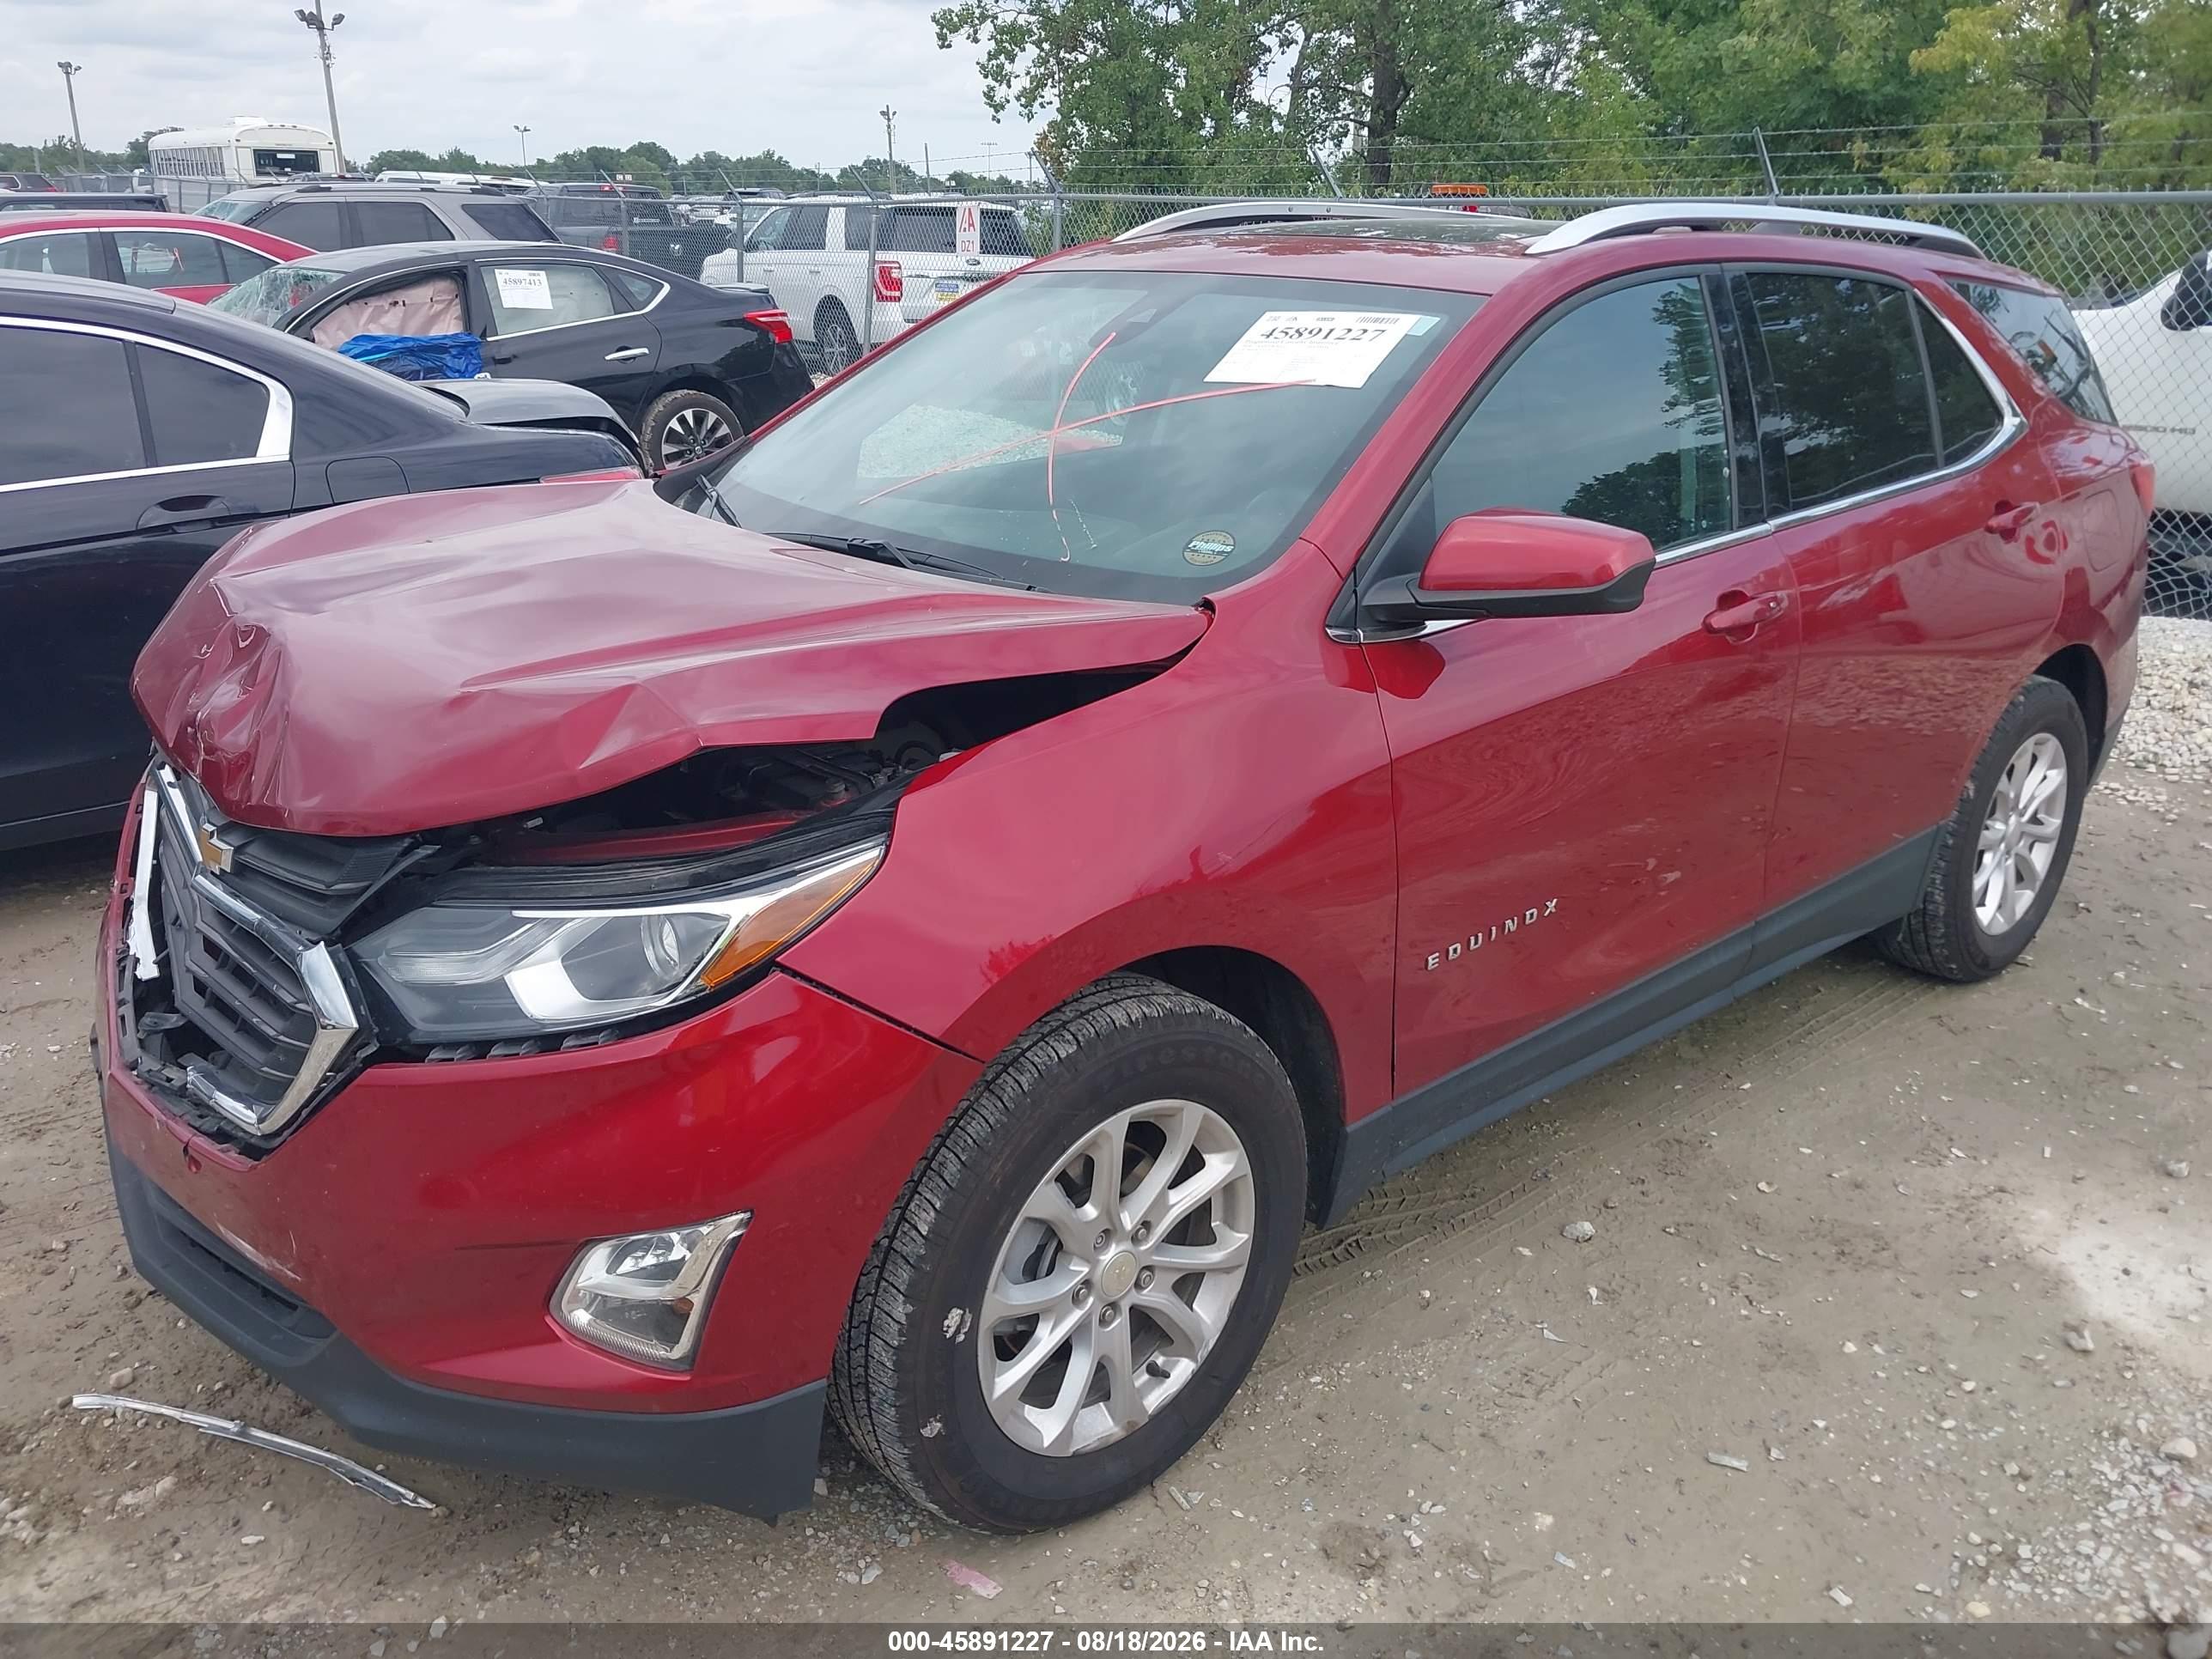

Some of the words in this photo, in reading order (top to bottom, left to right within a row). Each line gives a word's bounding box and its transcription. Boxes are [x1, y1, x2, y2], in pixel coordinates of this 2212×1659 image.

[961, 240, 975, 252] DZ1
[502, 277, 543, 287] 45897413
[1261, 326, 1387, 342] 45891227
[1425, 898, 1559, 971] EQUINOX
